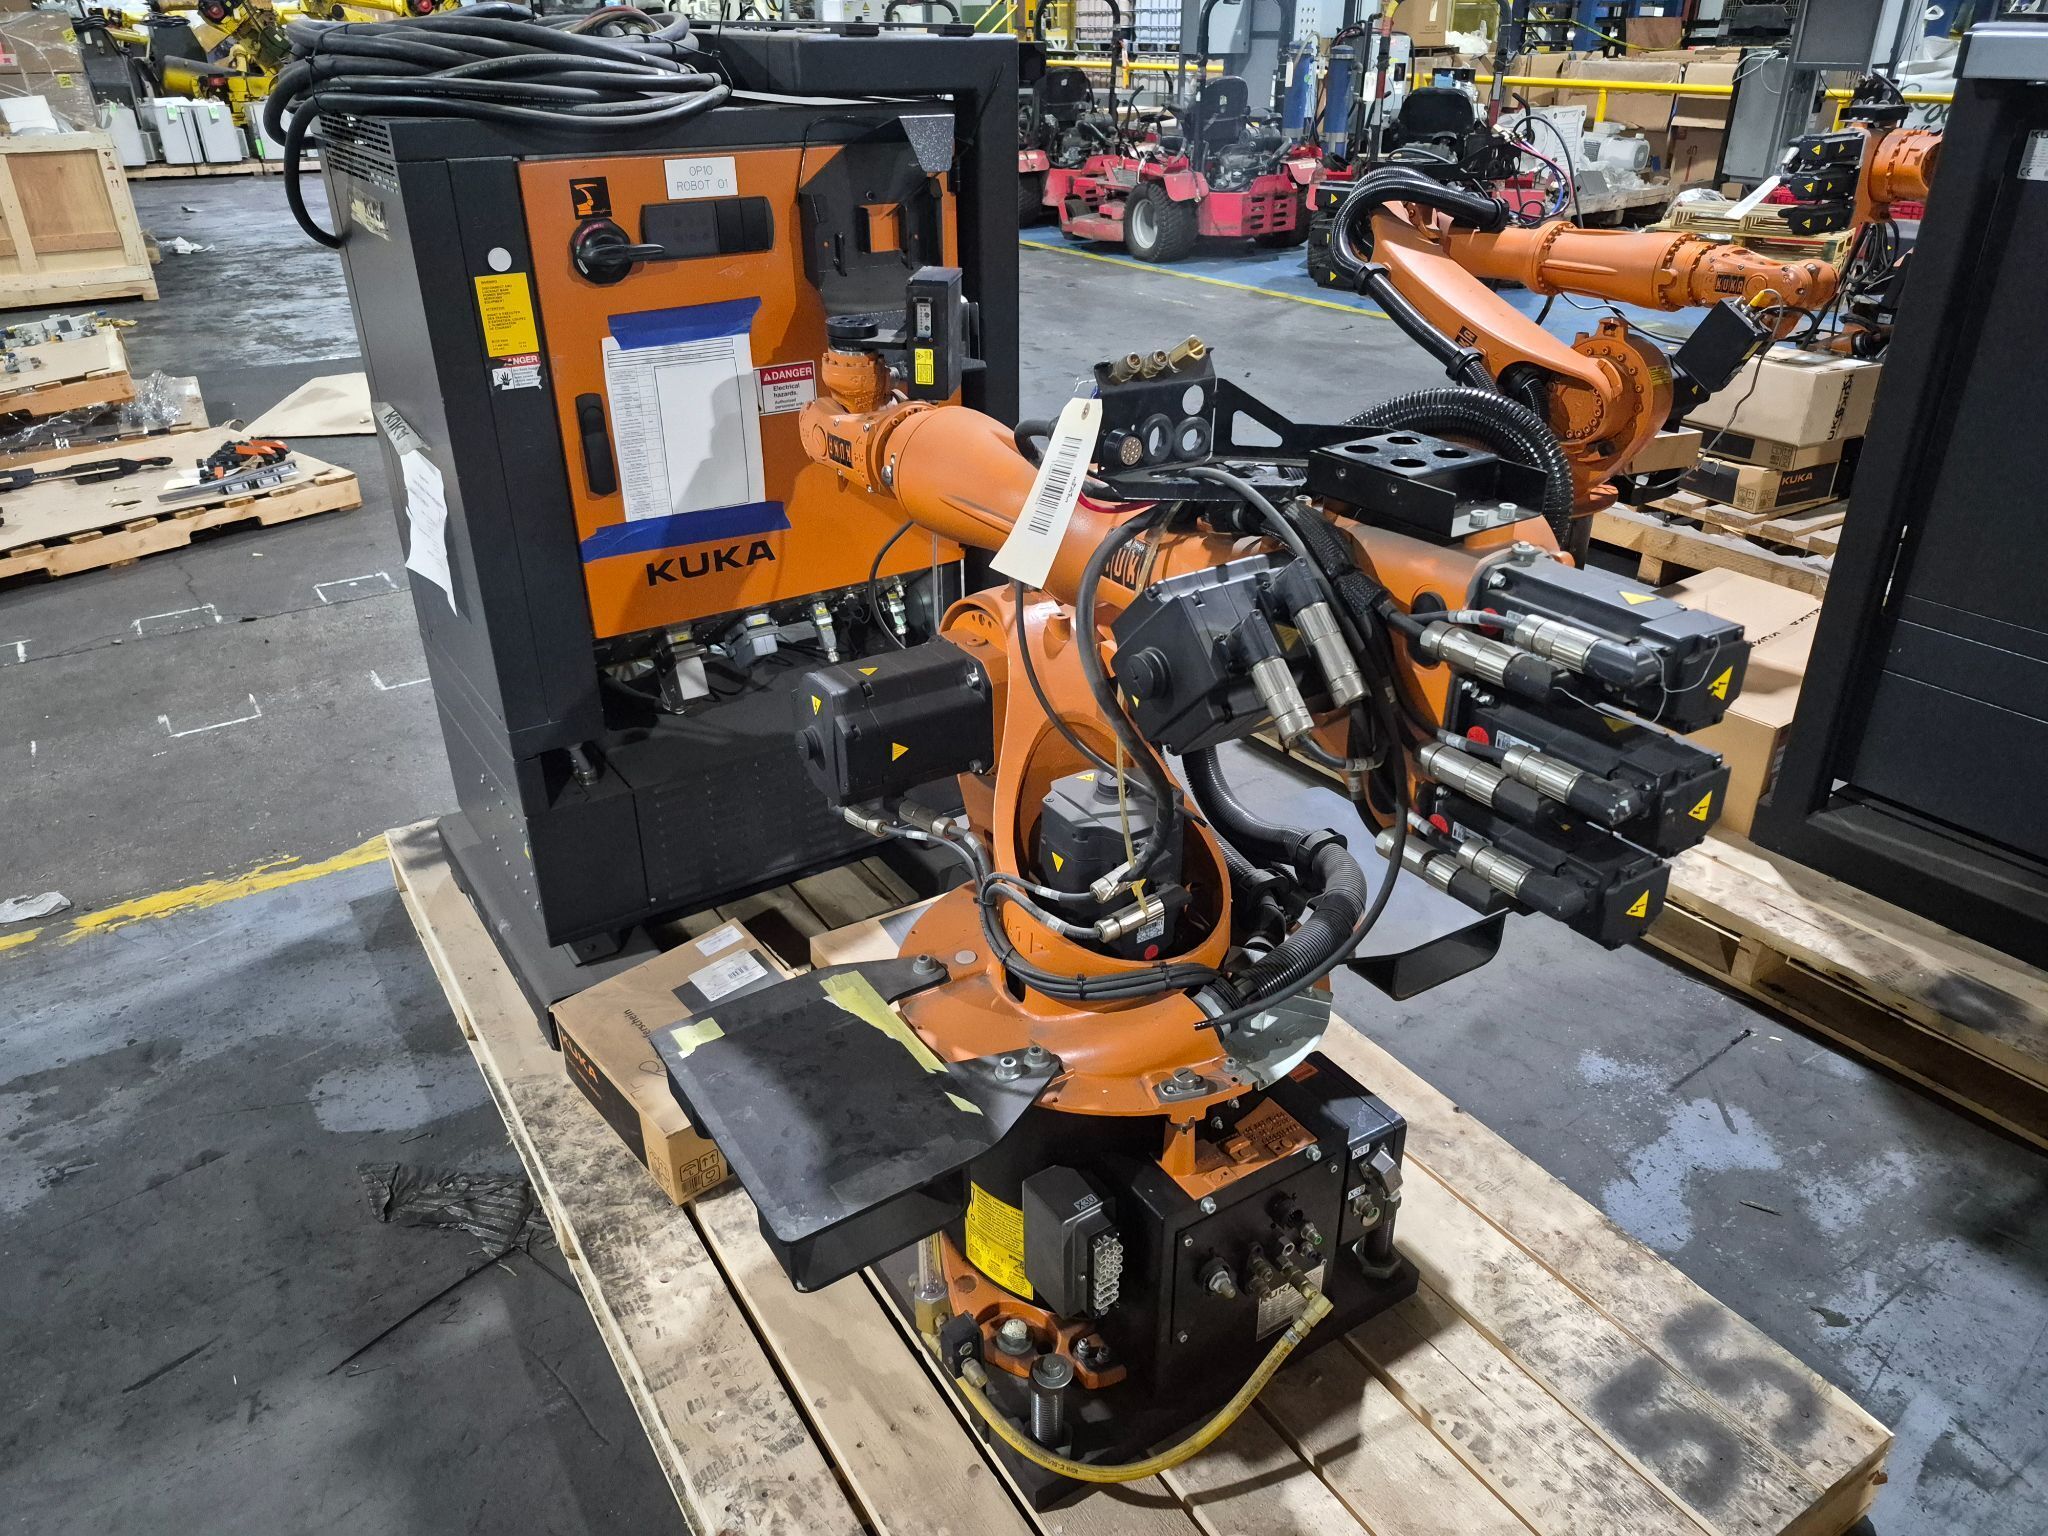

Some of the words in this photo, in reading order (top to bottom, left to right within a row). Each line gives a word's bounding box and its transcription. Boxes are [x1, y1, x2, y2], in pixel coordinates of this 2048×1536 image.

[677, 179, 711, 192] ROBOT
[507, 355, 539, 366] NGER
[771, 366, 813, 381] DANGER
[772, 382, 800, 392] Electrical
[1781, 471, 1813, 486] KUKA
[646, 539, 776, 587] KUKA
[1075, 1194, 1095, 1210] X30
